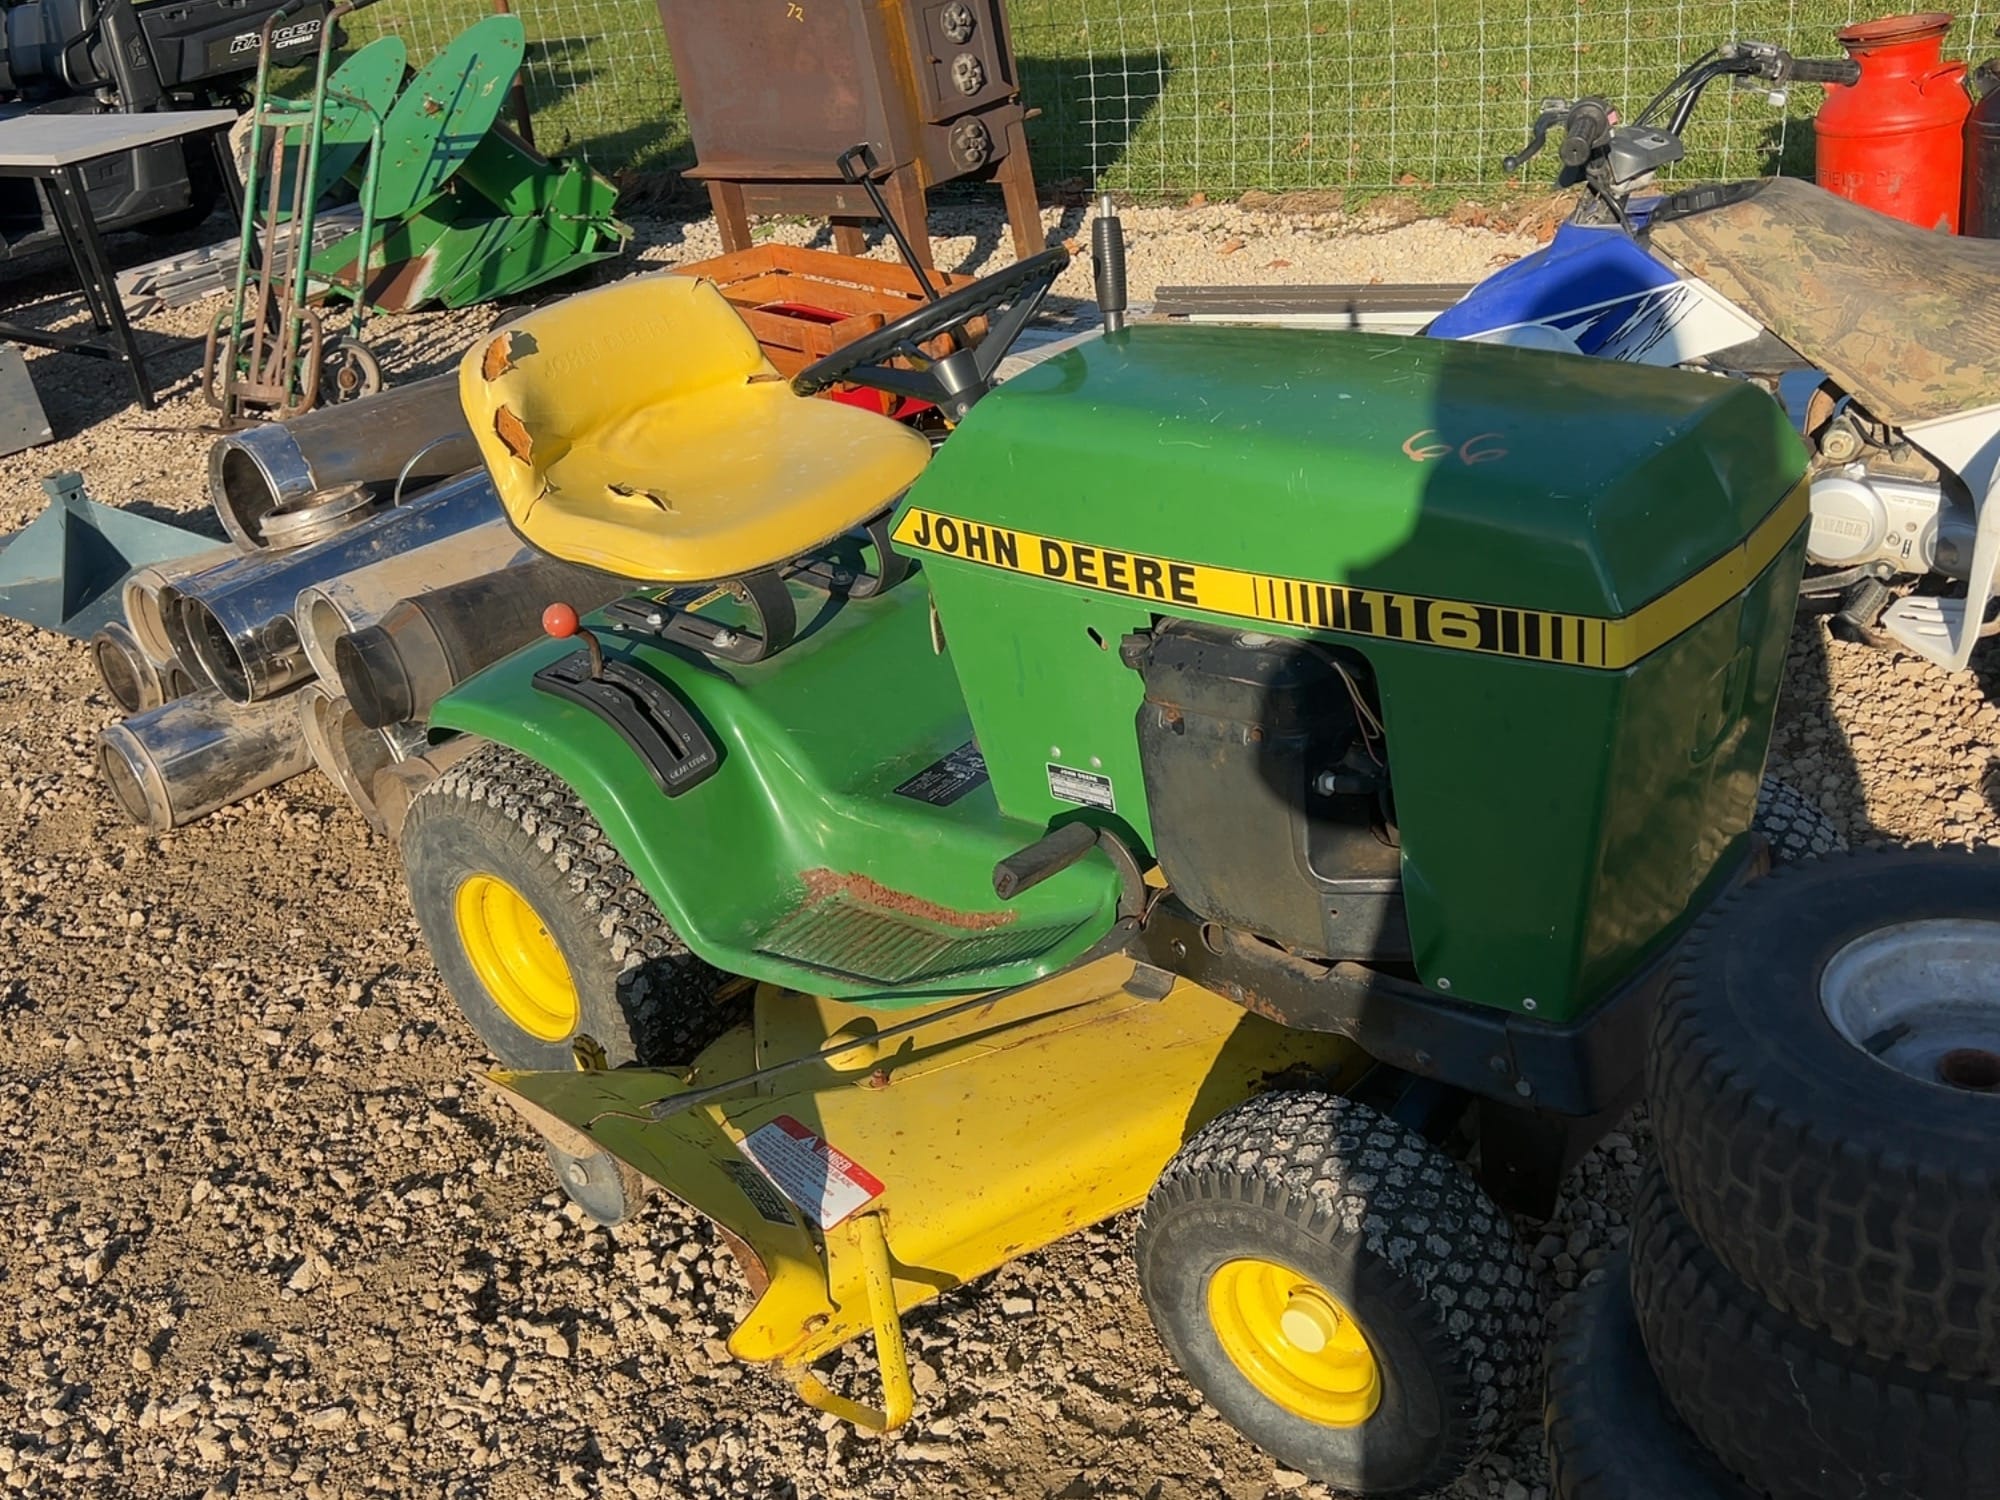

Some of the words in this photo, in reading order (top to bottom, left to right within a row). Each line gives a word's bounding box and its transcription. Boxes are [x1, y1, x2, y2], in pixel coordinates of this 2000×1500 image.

[787, 2, 804, 22] 72
[1402, 430, 1508, 465] 66
[913, 512, 1019, 568] JOHN
[1039, 539, 1198, 604] DEERE
[1361, 589, 1481, 649] 116
[816, 1145, 853, 1173] DANGER
